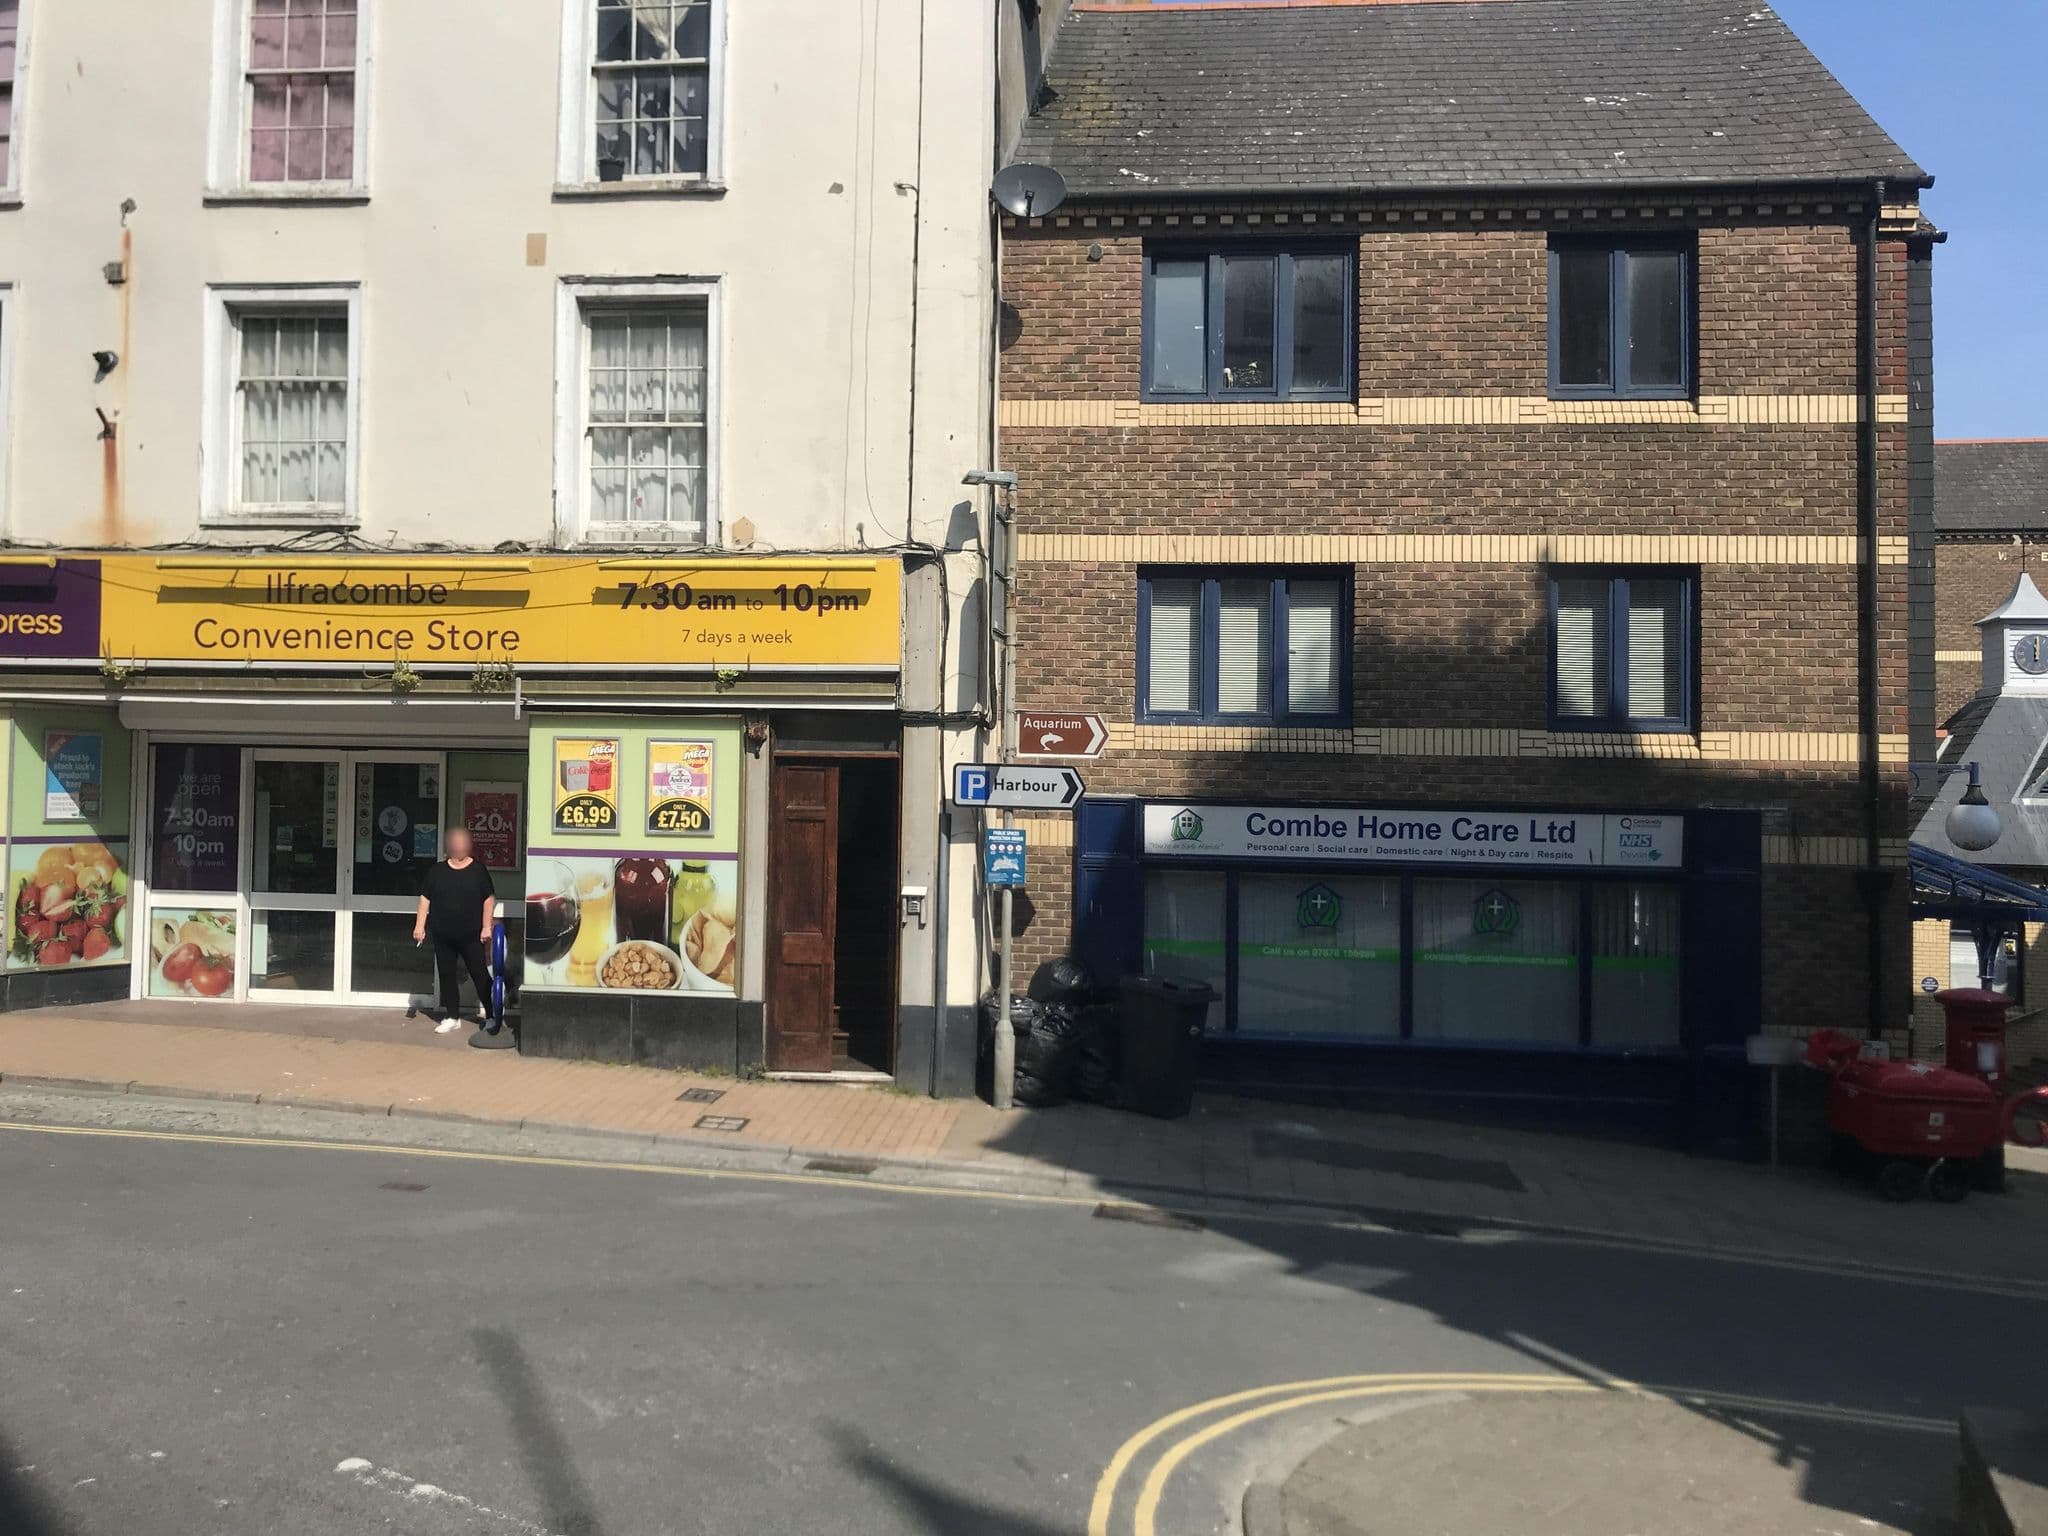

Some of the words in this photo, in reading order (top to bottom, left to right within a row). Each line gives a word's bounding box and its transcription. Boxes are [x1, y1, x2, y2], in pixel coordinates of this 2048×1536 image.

[267, 573, 448, 605] Ilfracombe
[746, 599, 763, 611] to
[193, 617, 414, 650] Convenience
[427, 619, 520, 651] Store
[682, 630, 690, 642] 7
[697, 630, 732, 647] days
[738, 633, 746, 643] a
[751, 631, 793, 643] week
[1023, 718, 1082, 730] Aquarium
[178, 784, 221, 800] open
[994, 778, 1057, 793] Harbour
[563, 806, 611, 824] £6.99
[658, 811, 702, 828] £7.50
[1246, 813, 1347, 838] Combe
[1358, 816, 1441, 840] Home
[1452, 818, 1518, 842] Care
[1530, 820, 1576, 843] Ltd
[1621, 835, 1650, 846] NHS
[1247, 843, 1287, 851] Personal
[1317, 845, 1346, 853] Social
[1376, 847, 1420, 855] Domestic
[1451, 849, 1476, 857] Night
[1479, 849, 1486, 857] &
[1489, 850, 1506, 858] Day
[1537, 851, 1574, 859] Respite
